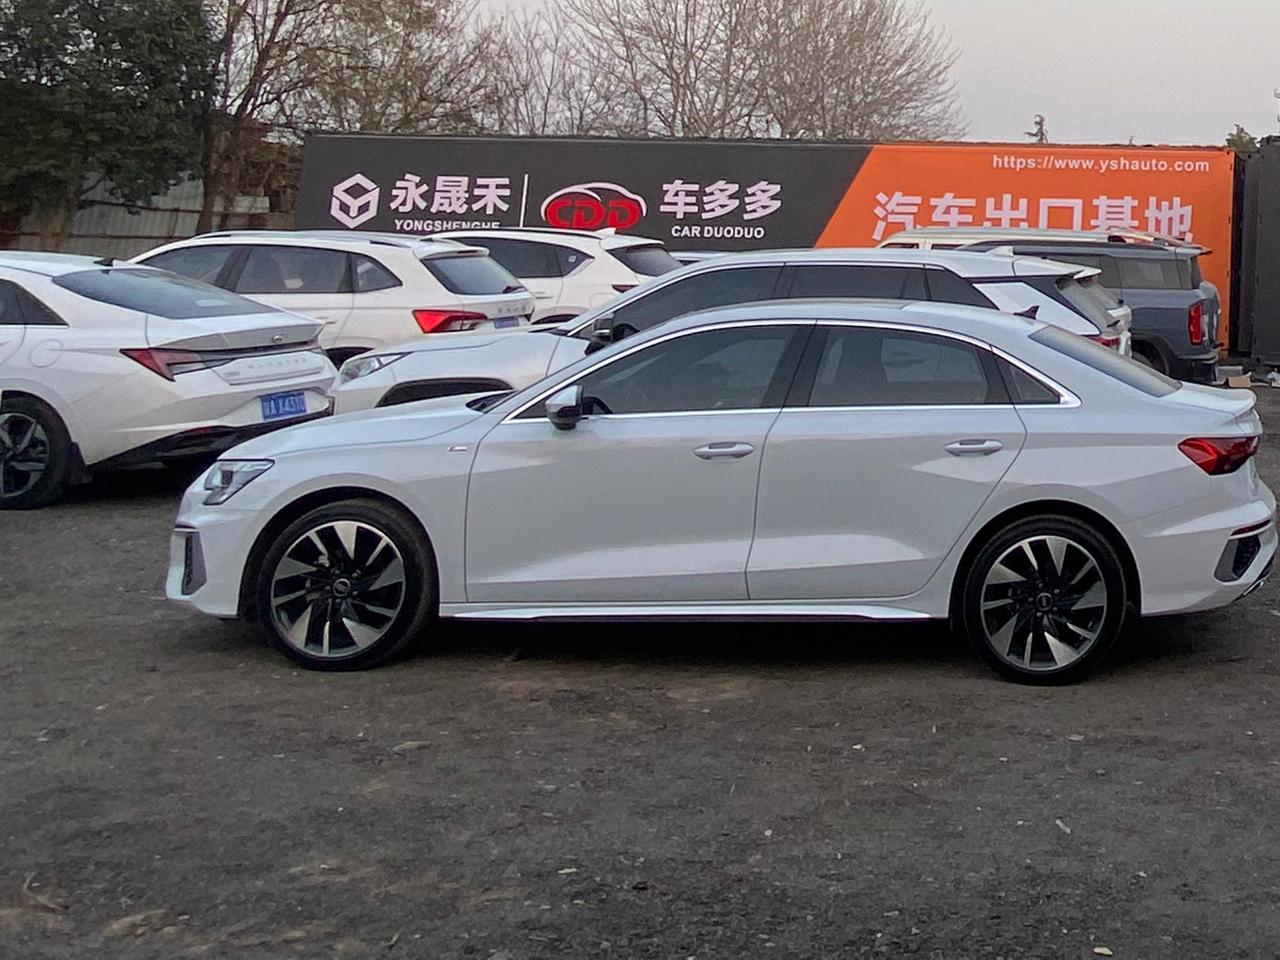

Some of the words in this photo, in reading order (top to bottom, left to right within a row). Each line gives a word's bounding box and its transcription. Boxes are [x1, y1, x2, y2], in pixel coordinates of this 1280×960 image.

[992, 154, 1210, 173] https://www.yshauto.com
[389, 173, 512, 215] 永晟禾
[659, 179, 782, 220] 车多多
[671, 225, 700, 238] CAR
[703, 226, 765, 239] DUODUO
[872, 191, 1194, 243] 汽车出口基地
